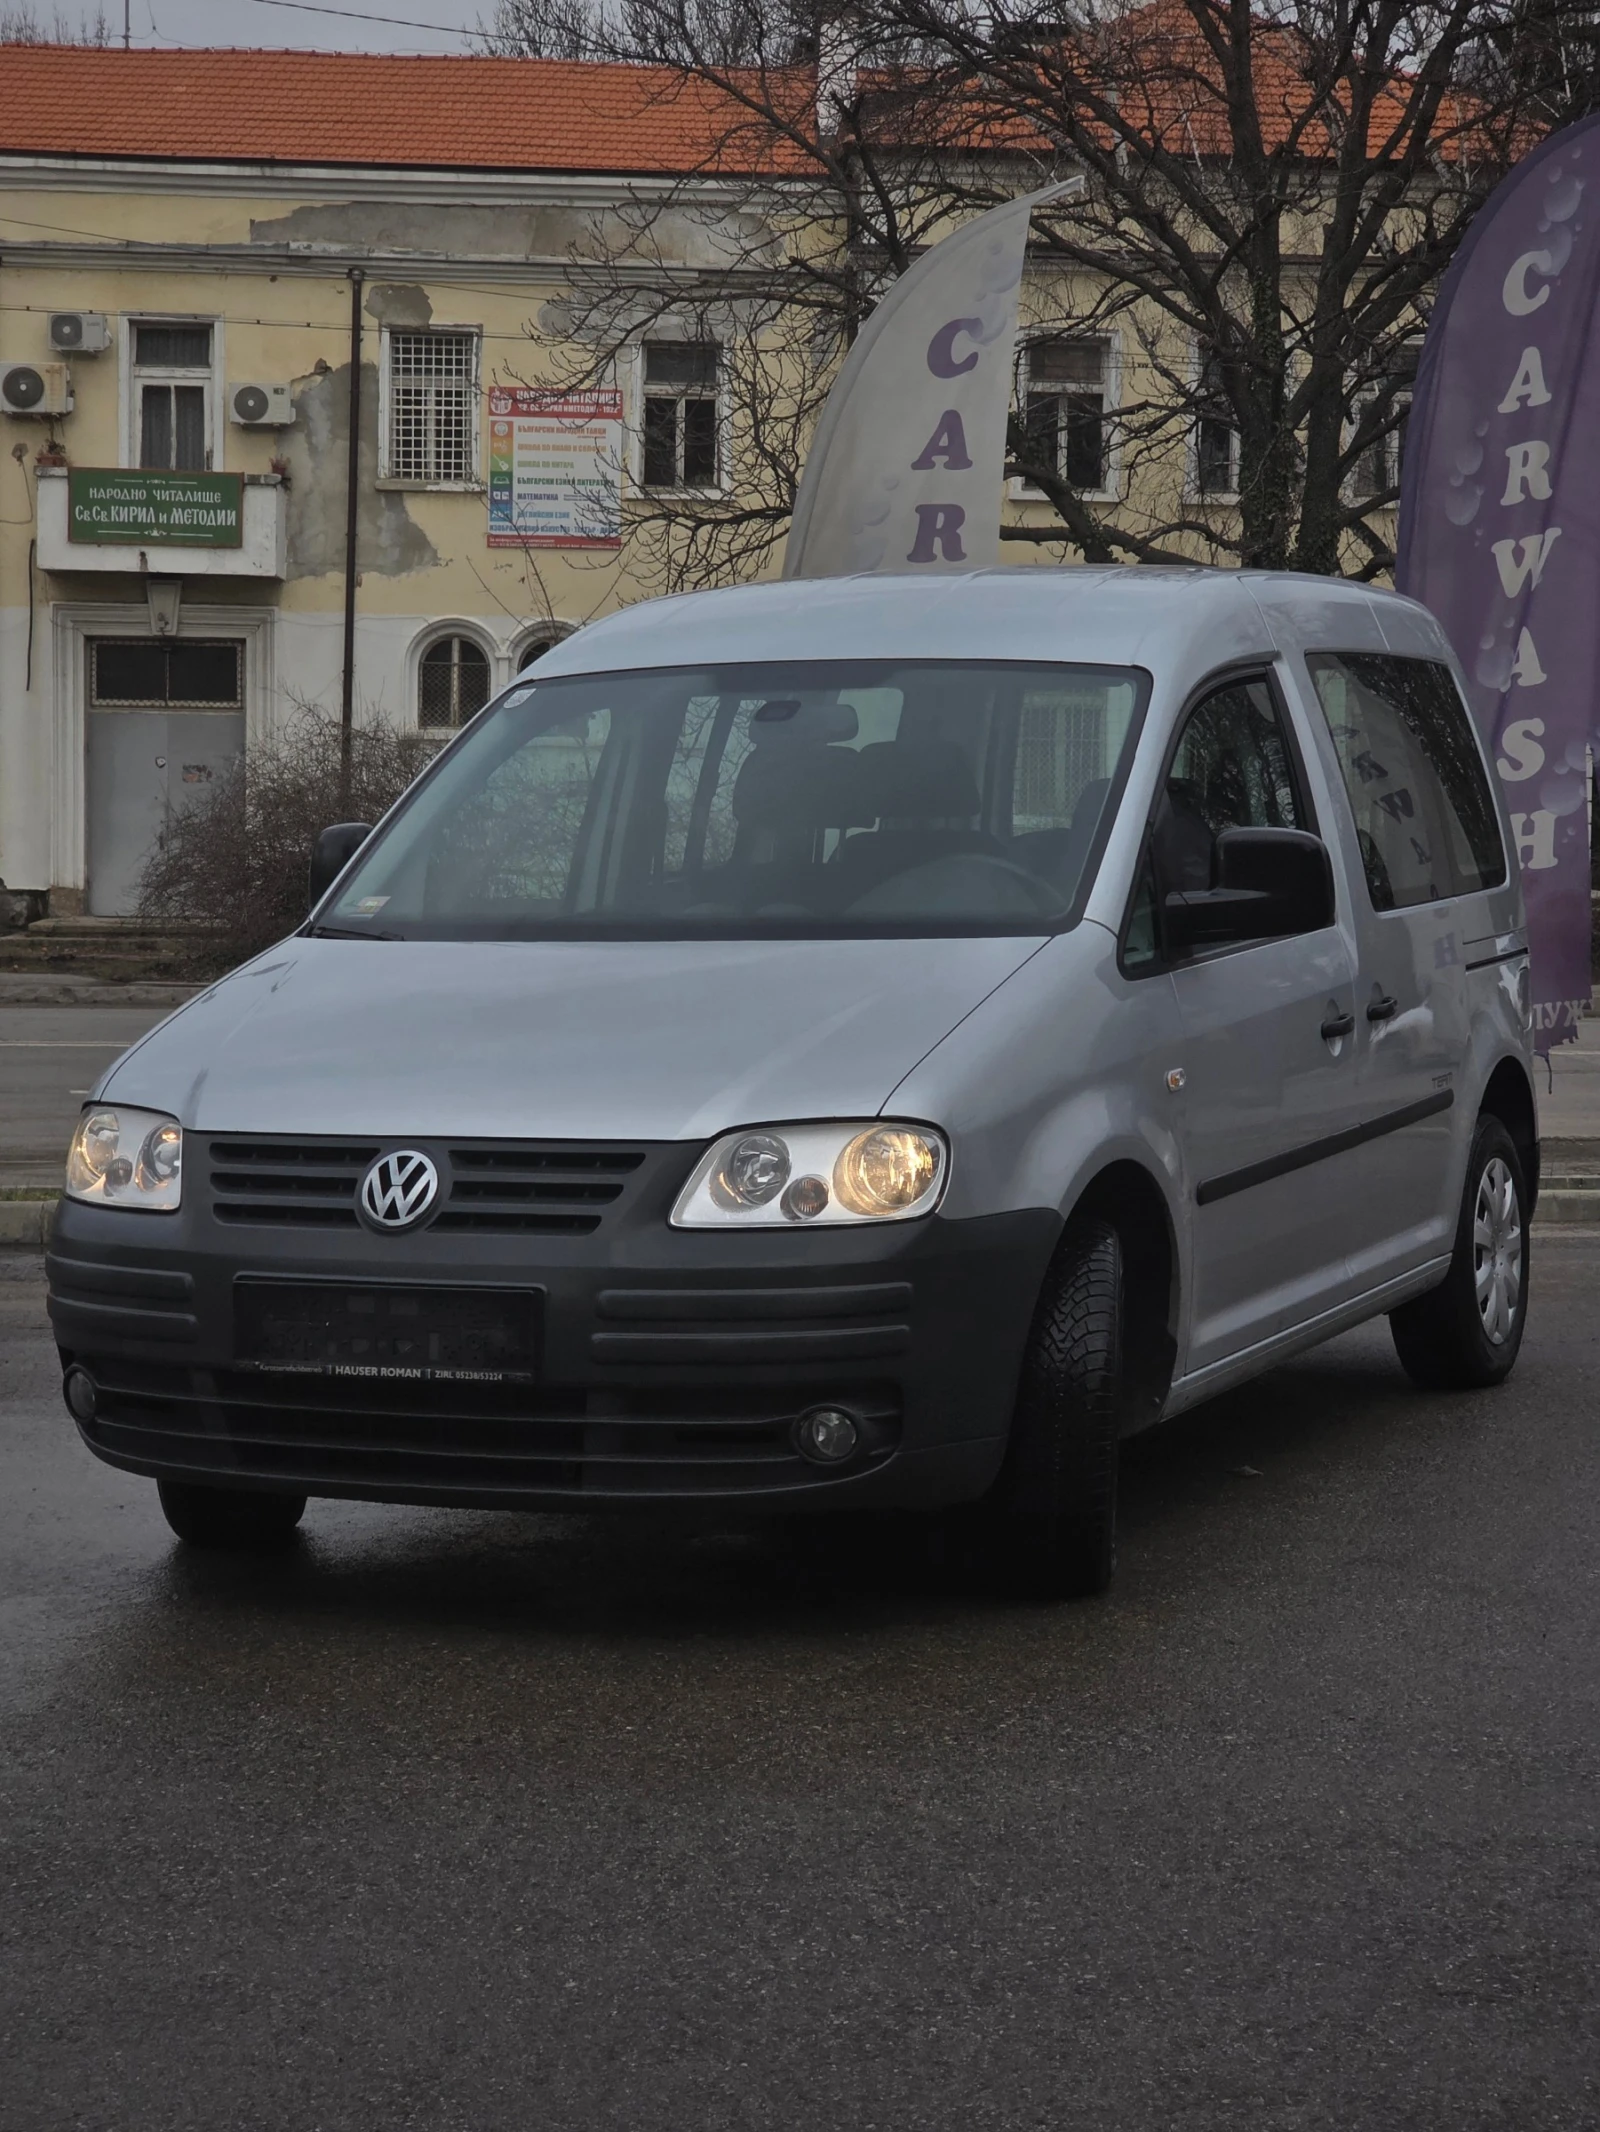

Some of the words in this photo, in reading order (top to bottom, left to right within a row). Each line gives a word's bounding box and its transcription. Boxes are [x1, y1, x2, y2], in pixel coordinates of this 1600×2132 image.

[906, 317, 984, 564] CAR
[517, 476, 555, 485] БЪЛГАРСКИ
[89, 487, 147, 501] НАРОДНО
[152, 489, 222, 503] ЧИТАЛИЩЕ
[517, 492, 559, 500] МАТЕМАТИКА
[110, 505, 156, 524] КИРИЛ
[170, 507, 237, 527] МЕТОДИЙ
[361, 1149, 438, 1226] VW
[335, 1365, 379, 1377] HAUSER
[380, 1367, 421, 1378] ROMAN
[434, 1369, 454, 1379] ZIRL
